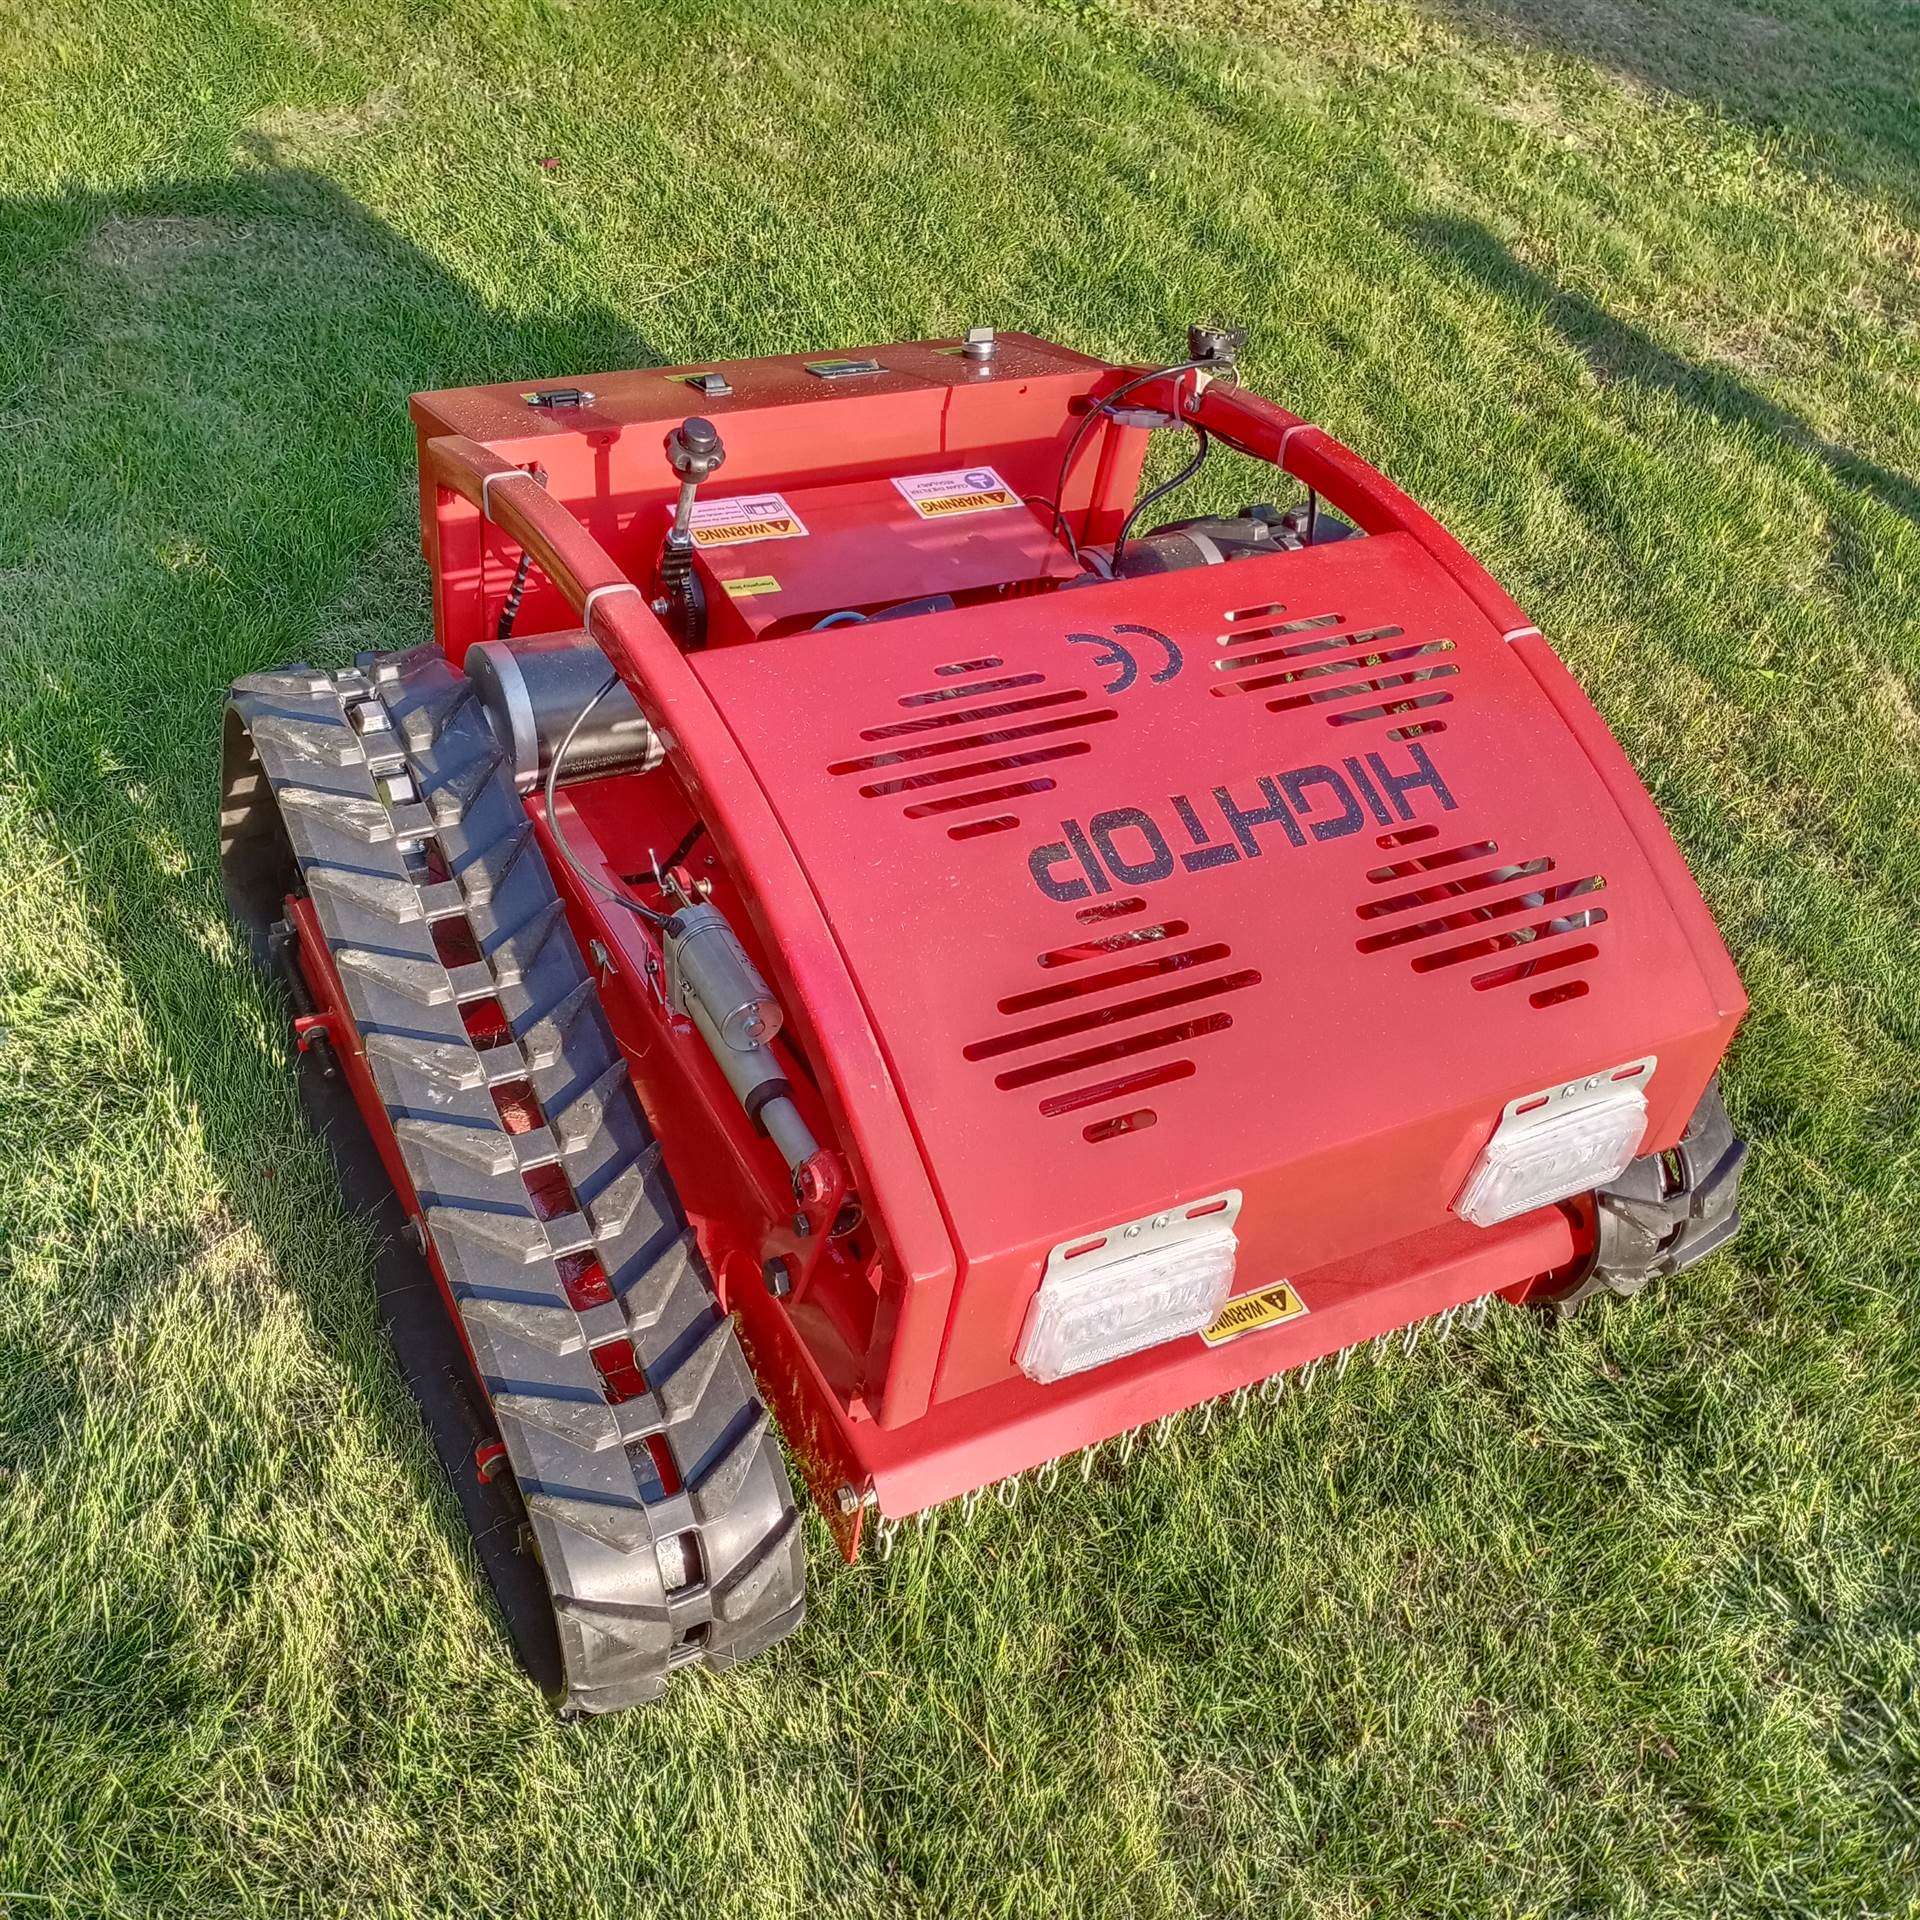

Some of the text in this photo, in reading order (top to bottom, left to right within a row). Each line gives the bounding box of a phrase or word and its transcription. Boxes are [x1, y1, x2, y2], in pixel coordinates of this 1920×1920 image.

[920, 495, 990, 512] WARNING
[695, 523, 771, 541] WARNING
[1028, 742, 1458, 902] HIGHTOP
